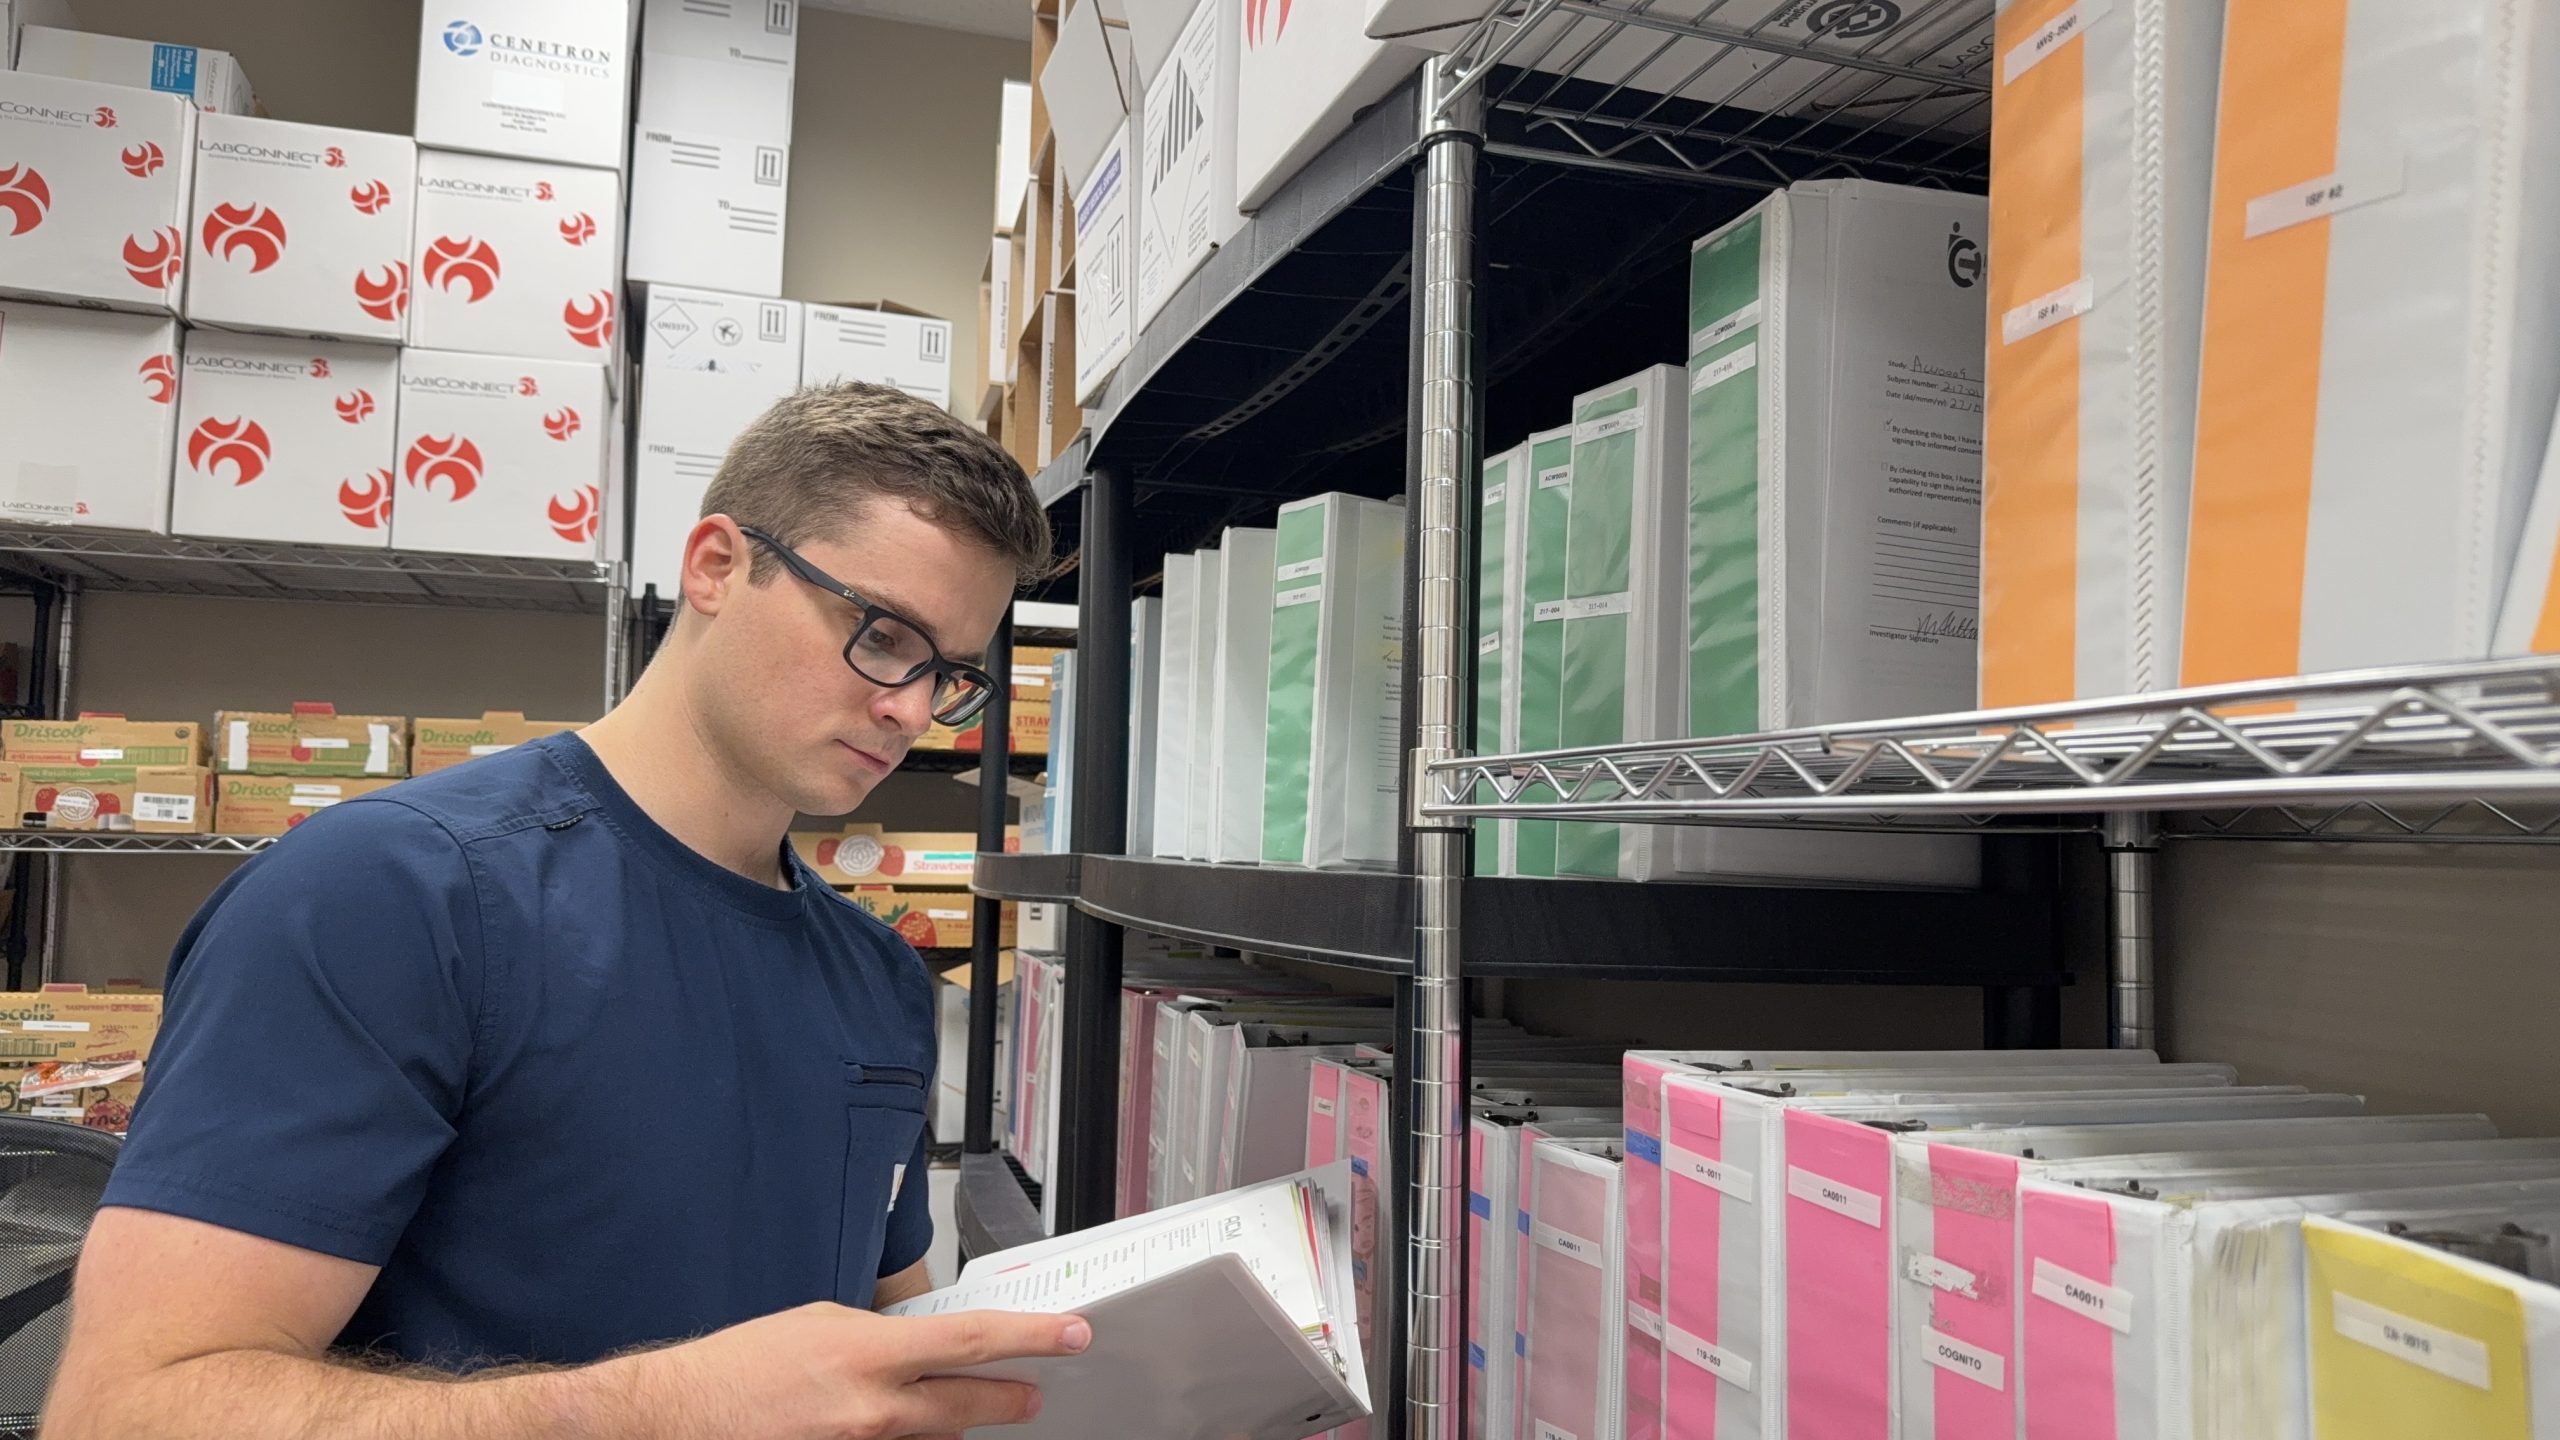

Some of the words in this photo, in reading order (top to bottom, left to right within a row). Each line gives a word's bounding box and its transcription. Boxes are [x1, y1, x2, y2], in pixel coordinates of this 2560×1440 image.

[490, 34, 611, 63] CENETRON
[729, 47, 741, 58] TO
[490, 51, 610, 79] DIAGNOSTICS
[200, 139, 321, 164] LABCONNECT
[419, 177, 532, 198] LABCONNECT
[718, 200, 730, 210] TO
[814, 311, 840, 322] FROM
[186, 355, 306, 375] LABCONNECT
[402, 374, 515, 394] LABCONNECT
[1886, 389, 1901, 400] Date
[1892, 425, 1901, 434] By
[1902, 428, 1930, 439] checking
[1930, 431, 1942, 440] this
[1891, 437, 1914, 447] signing
[1915, 439, 1927, 448] the
[1927, 441, 1957, 453] informed
[1889, 465, 1898, 474] By
[1899, 466, 1927, 478] checking
[1927, 470, 1940, 480] this
[1888, 486, 1923, 498] authorized
[1889, 476, 1920, 488] capability
[1920, 480, 1928, 488] to
[1929, 482, 1942, 491] sign
[1943, 484, 1955, 492] this
[1877, 516, 1912, 528] Comments
[1913, 520, 1921, 529] (if
[1869, 629, 1908, 642] Investigator
[1909, 633, 1940, 645] Signature
[1696, 1164, 1721, 1181] CA-0011
[1822, 1188, 1847, 1205] CA0011
[1558, 1237, 1581, 1253] CA0011
[2065, 1284, 2104, 1309] CA0011
[1696, 1347, 1721, 1367] 119-053
[1938, 1344, 1982, 1371] COGNITO
